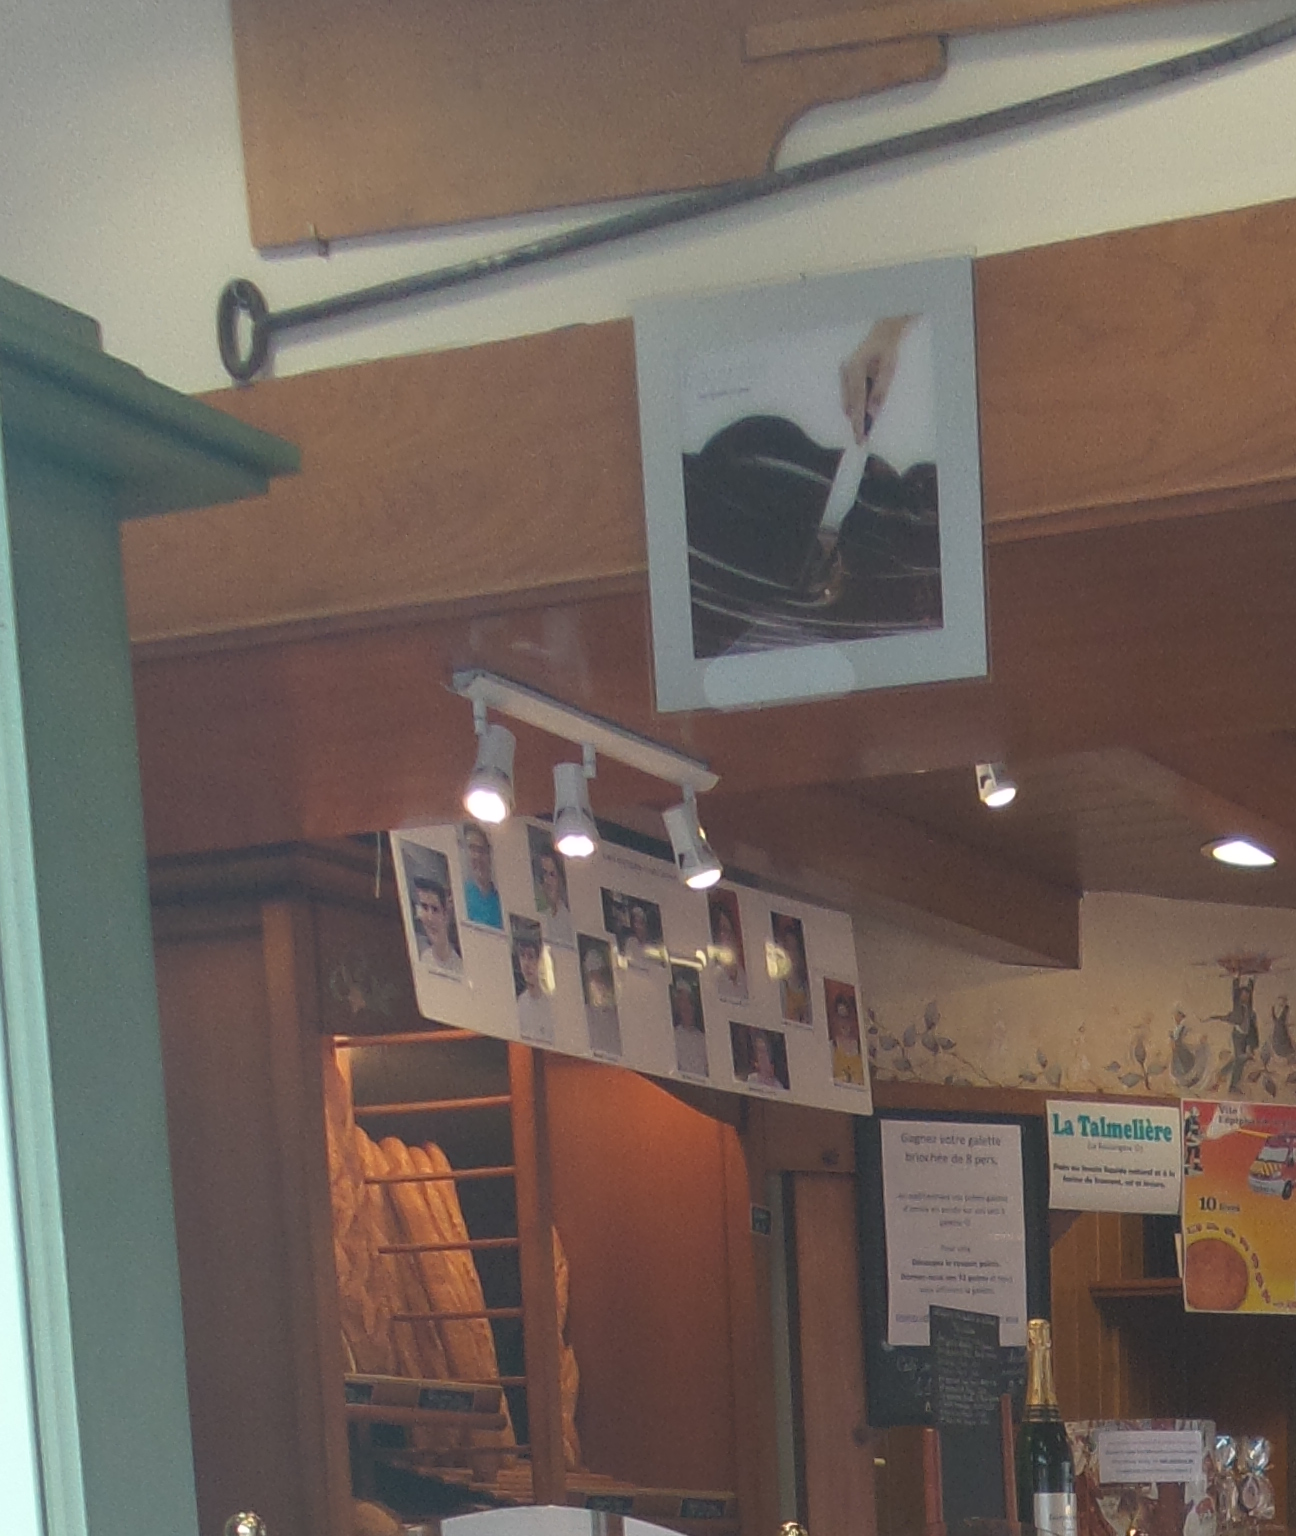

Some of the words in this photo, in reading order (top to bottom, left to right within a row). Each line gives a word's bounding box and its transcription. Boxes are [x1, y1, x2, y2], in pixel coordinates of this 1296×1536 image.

[1052, 1113, 1075, 1136] La
[1077, 1114, 1173, 1142] Talmelière
[900, 1133, 937, 1147] Gagnez
[939, 1134, 966, 1145] votre
[968, 1134, 1002, 1148] galette
[905, 1153, 948, 1163] briochée
[951, 1154, 964, 1164] de
[966, 1154, 973, 1164] 8
[1199, 1196, 1217, 1211] 10
